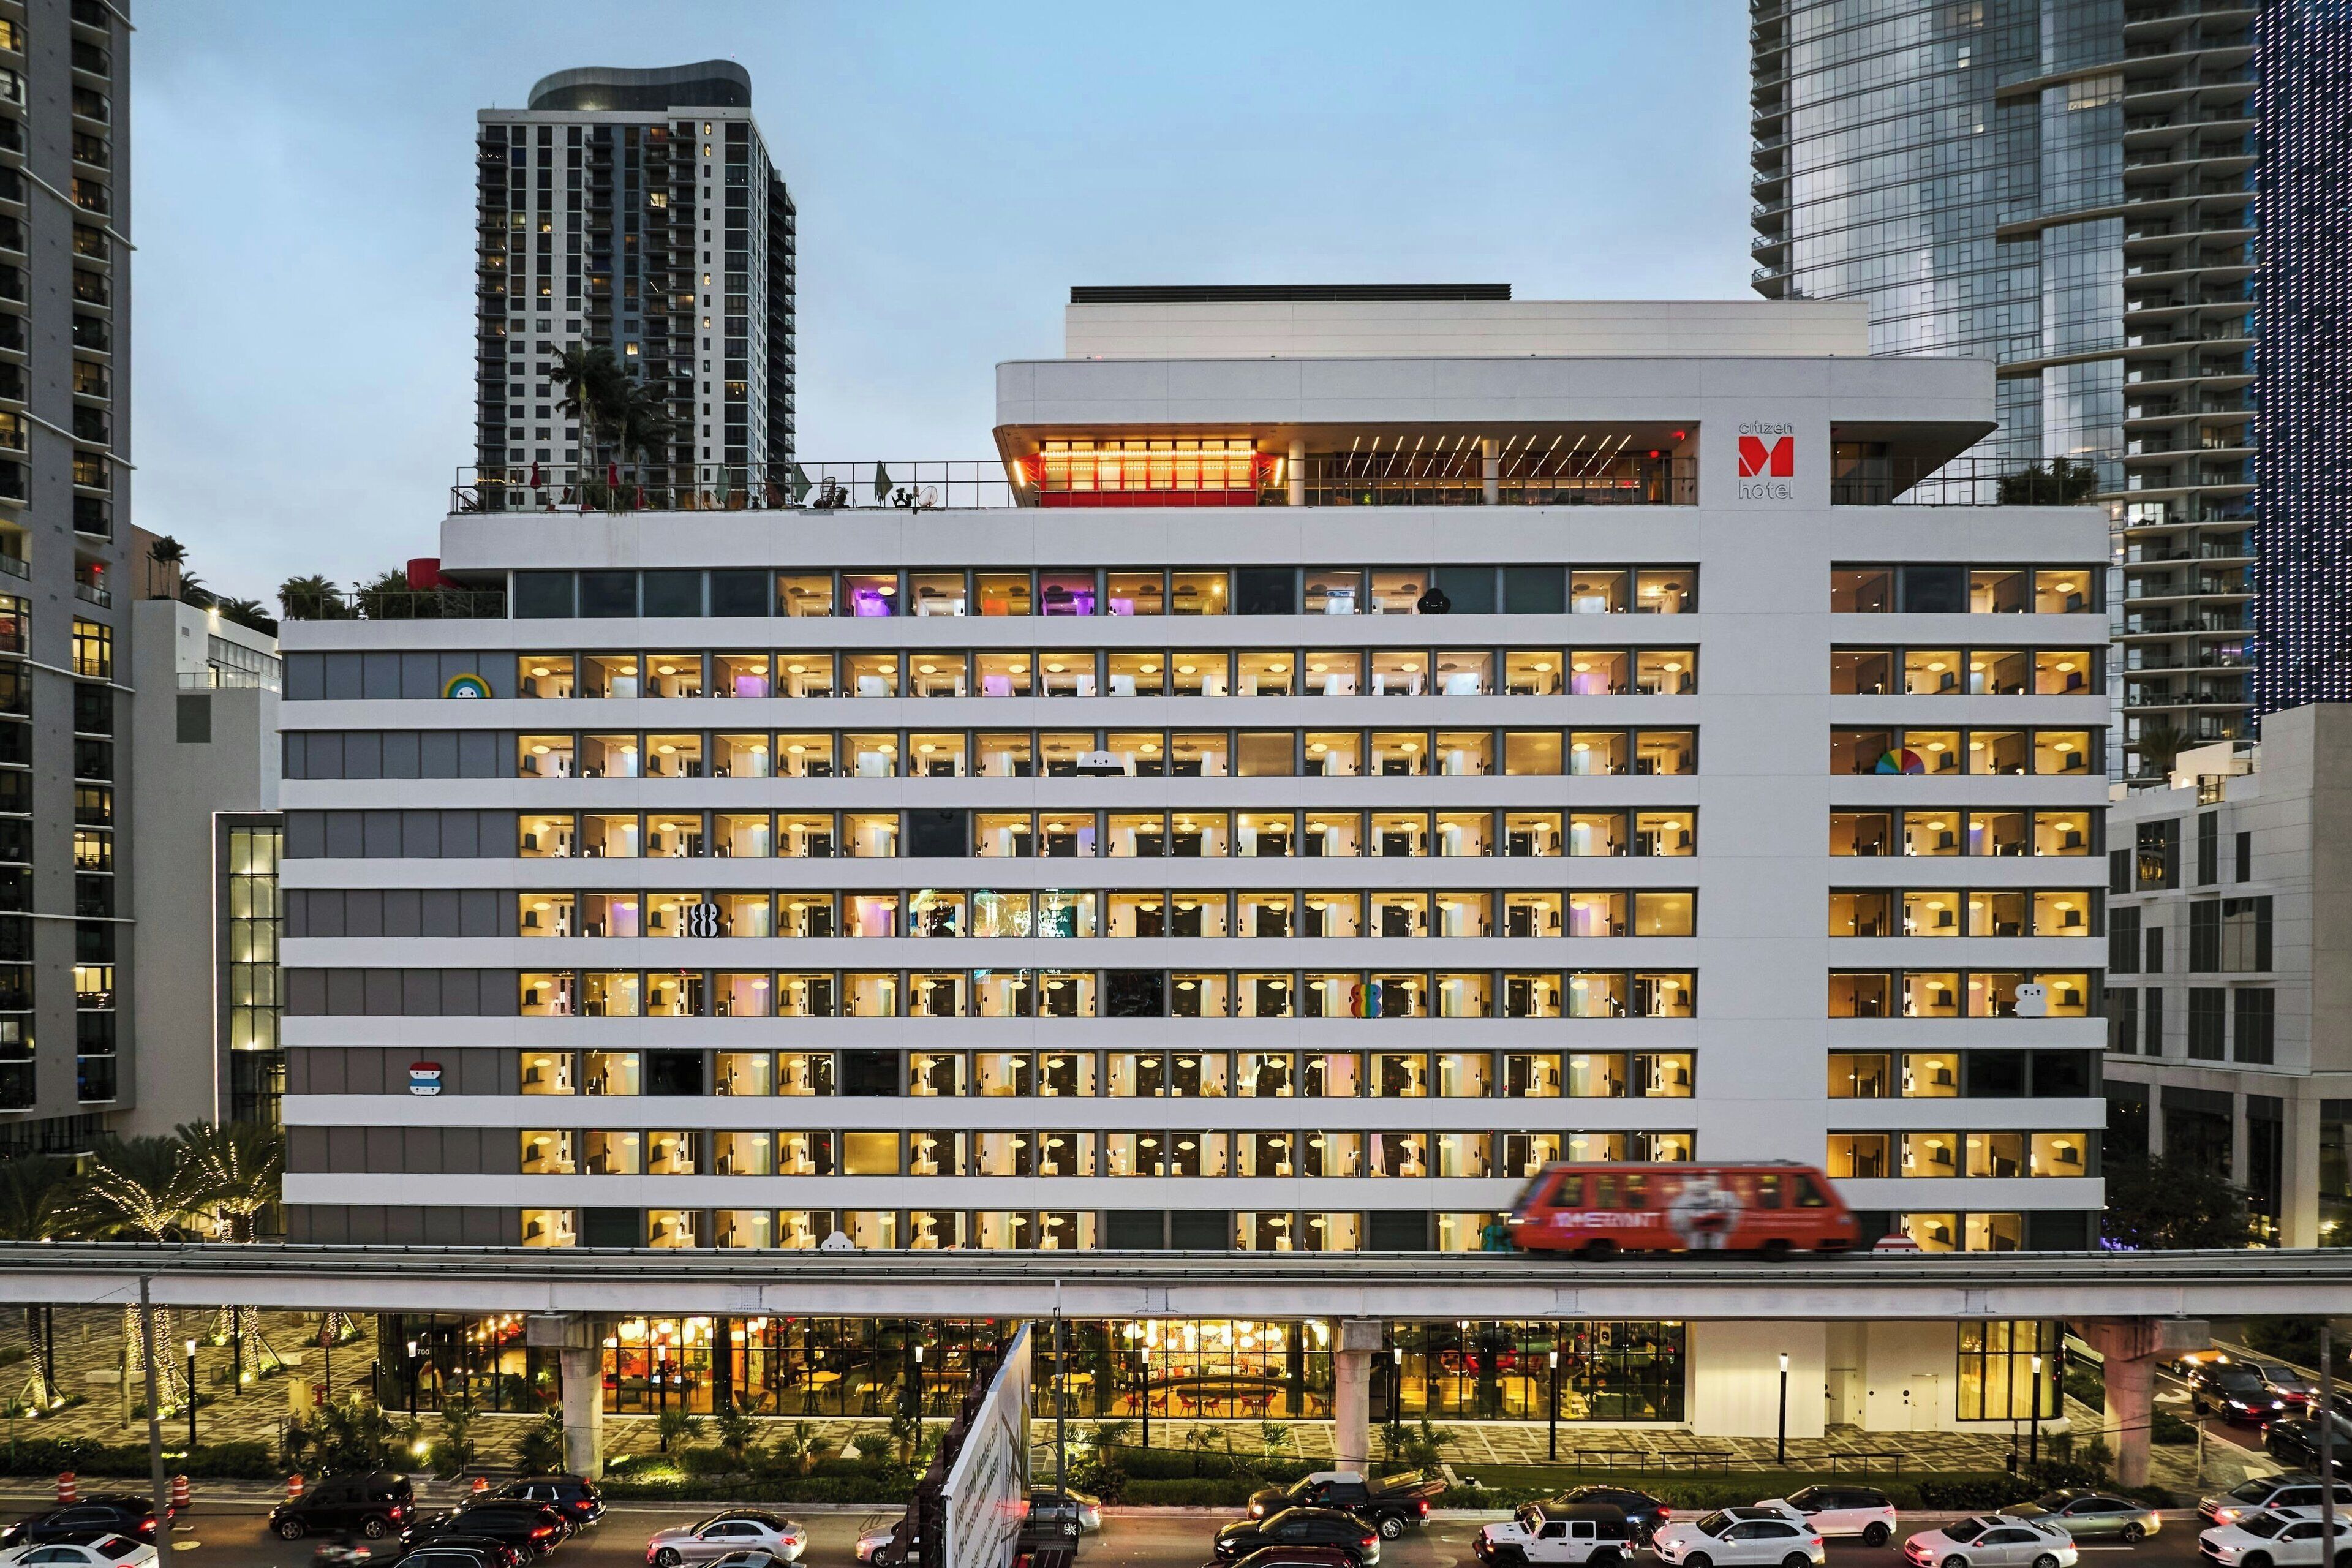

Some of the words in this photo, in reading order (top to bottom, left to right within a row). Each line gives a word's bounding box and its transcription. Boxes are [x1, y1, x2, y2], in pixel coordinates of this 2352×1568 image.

[1738, 420, 1793, 434] citizen
[1738, 436, 1794, 477] M
[1738, 480, 1793, 499] hotel
[956, 1498, 965, 1533] Keep
[965, 1468, 976, 1509] Family
[977, 1438, 991, 1480] Members
[965, 1483, 987, 1545] Construction
